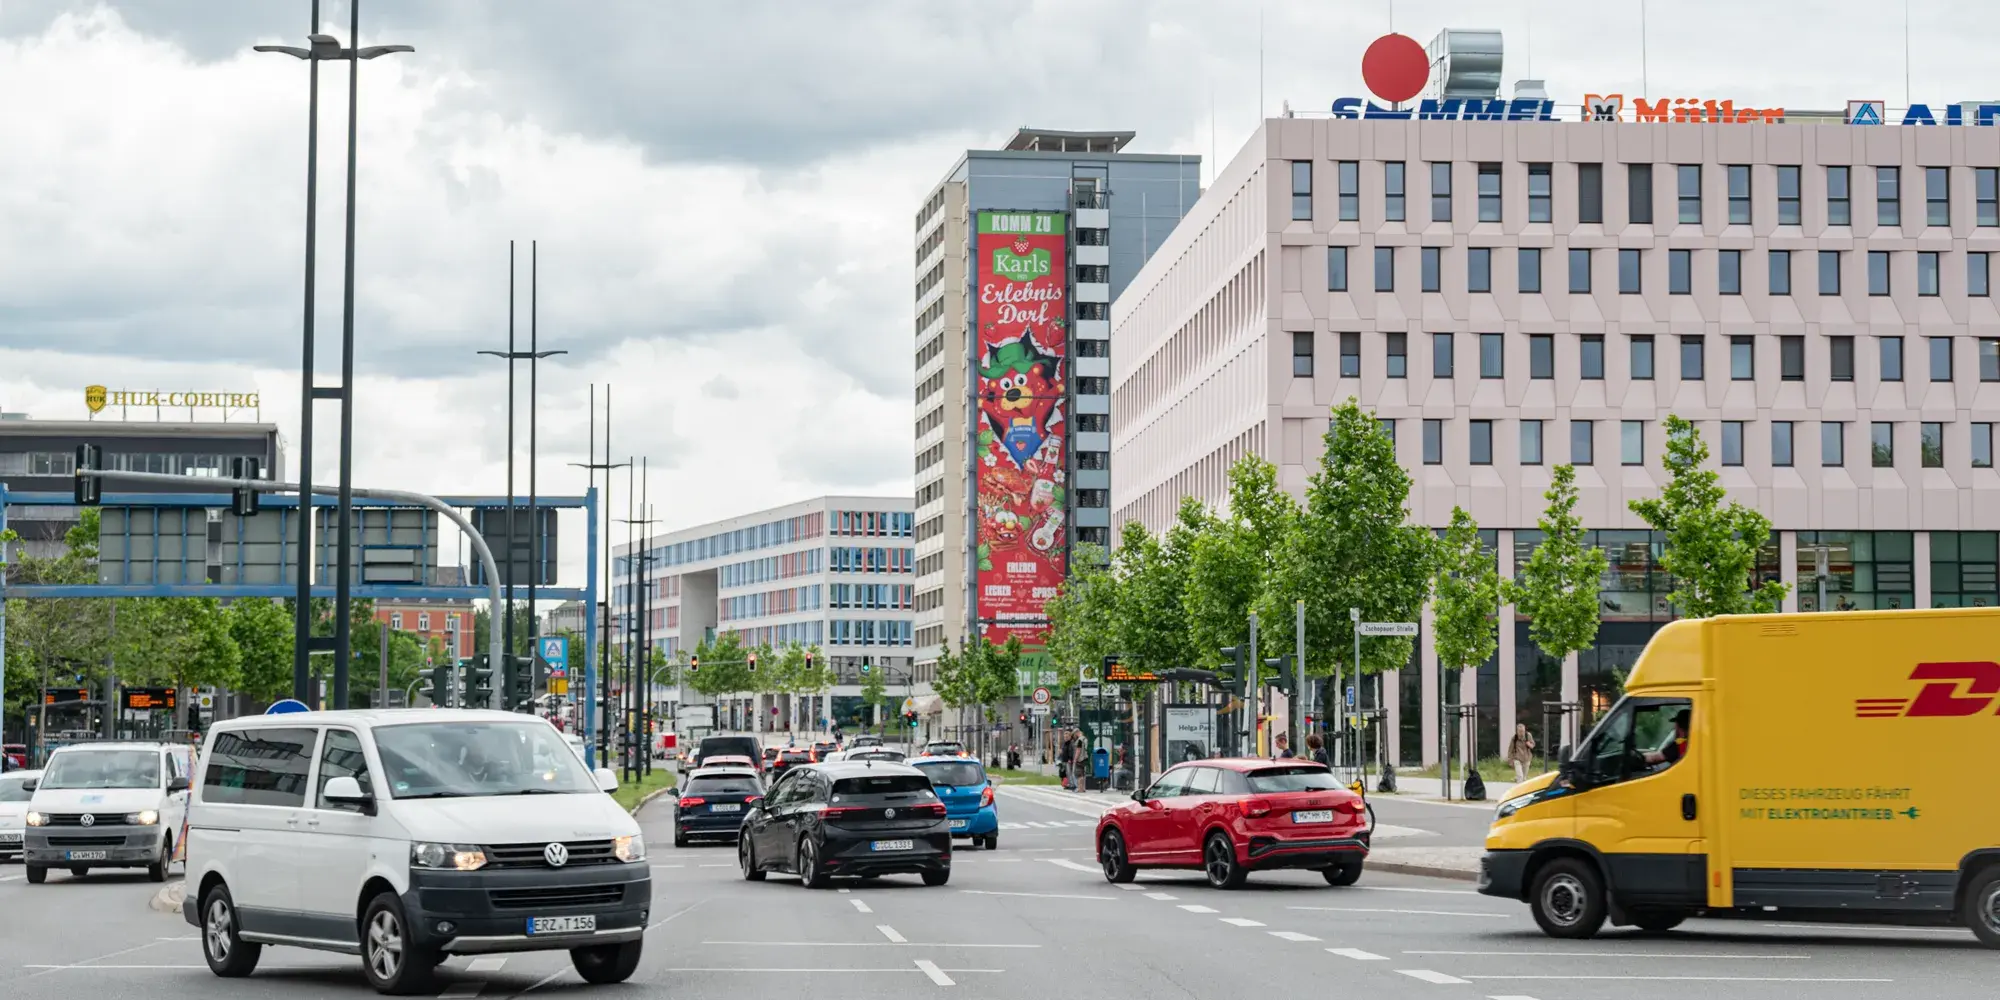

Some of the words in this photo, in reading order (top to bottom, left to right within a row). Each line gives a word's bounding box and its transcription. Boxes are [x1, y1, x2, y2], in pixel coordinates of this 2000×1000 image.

[1632, 98, 1785, 124] Müller
[992, 215, 1031, 232] KOMM
[1035, 215, 1052, 232] ZU
[996, 254, 1048, 273] Karls
[982, 282, 1062, 304] Erlebnis
[998, 302, 1049, 326] Dorf
[112, 391, 260, 408] HUK-COBURG
[1365, 625, 1395, 633] Zschopauer
[1739, 788, 1787, 800] DIESES
[1789, 788, 1863, 800] FAHRZEUG
[1866, 785, 1912, 800] FÄHRT
[1740, 808, 1765, 820] MIT
